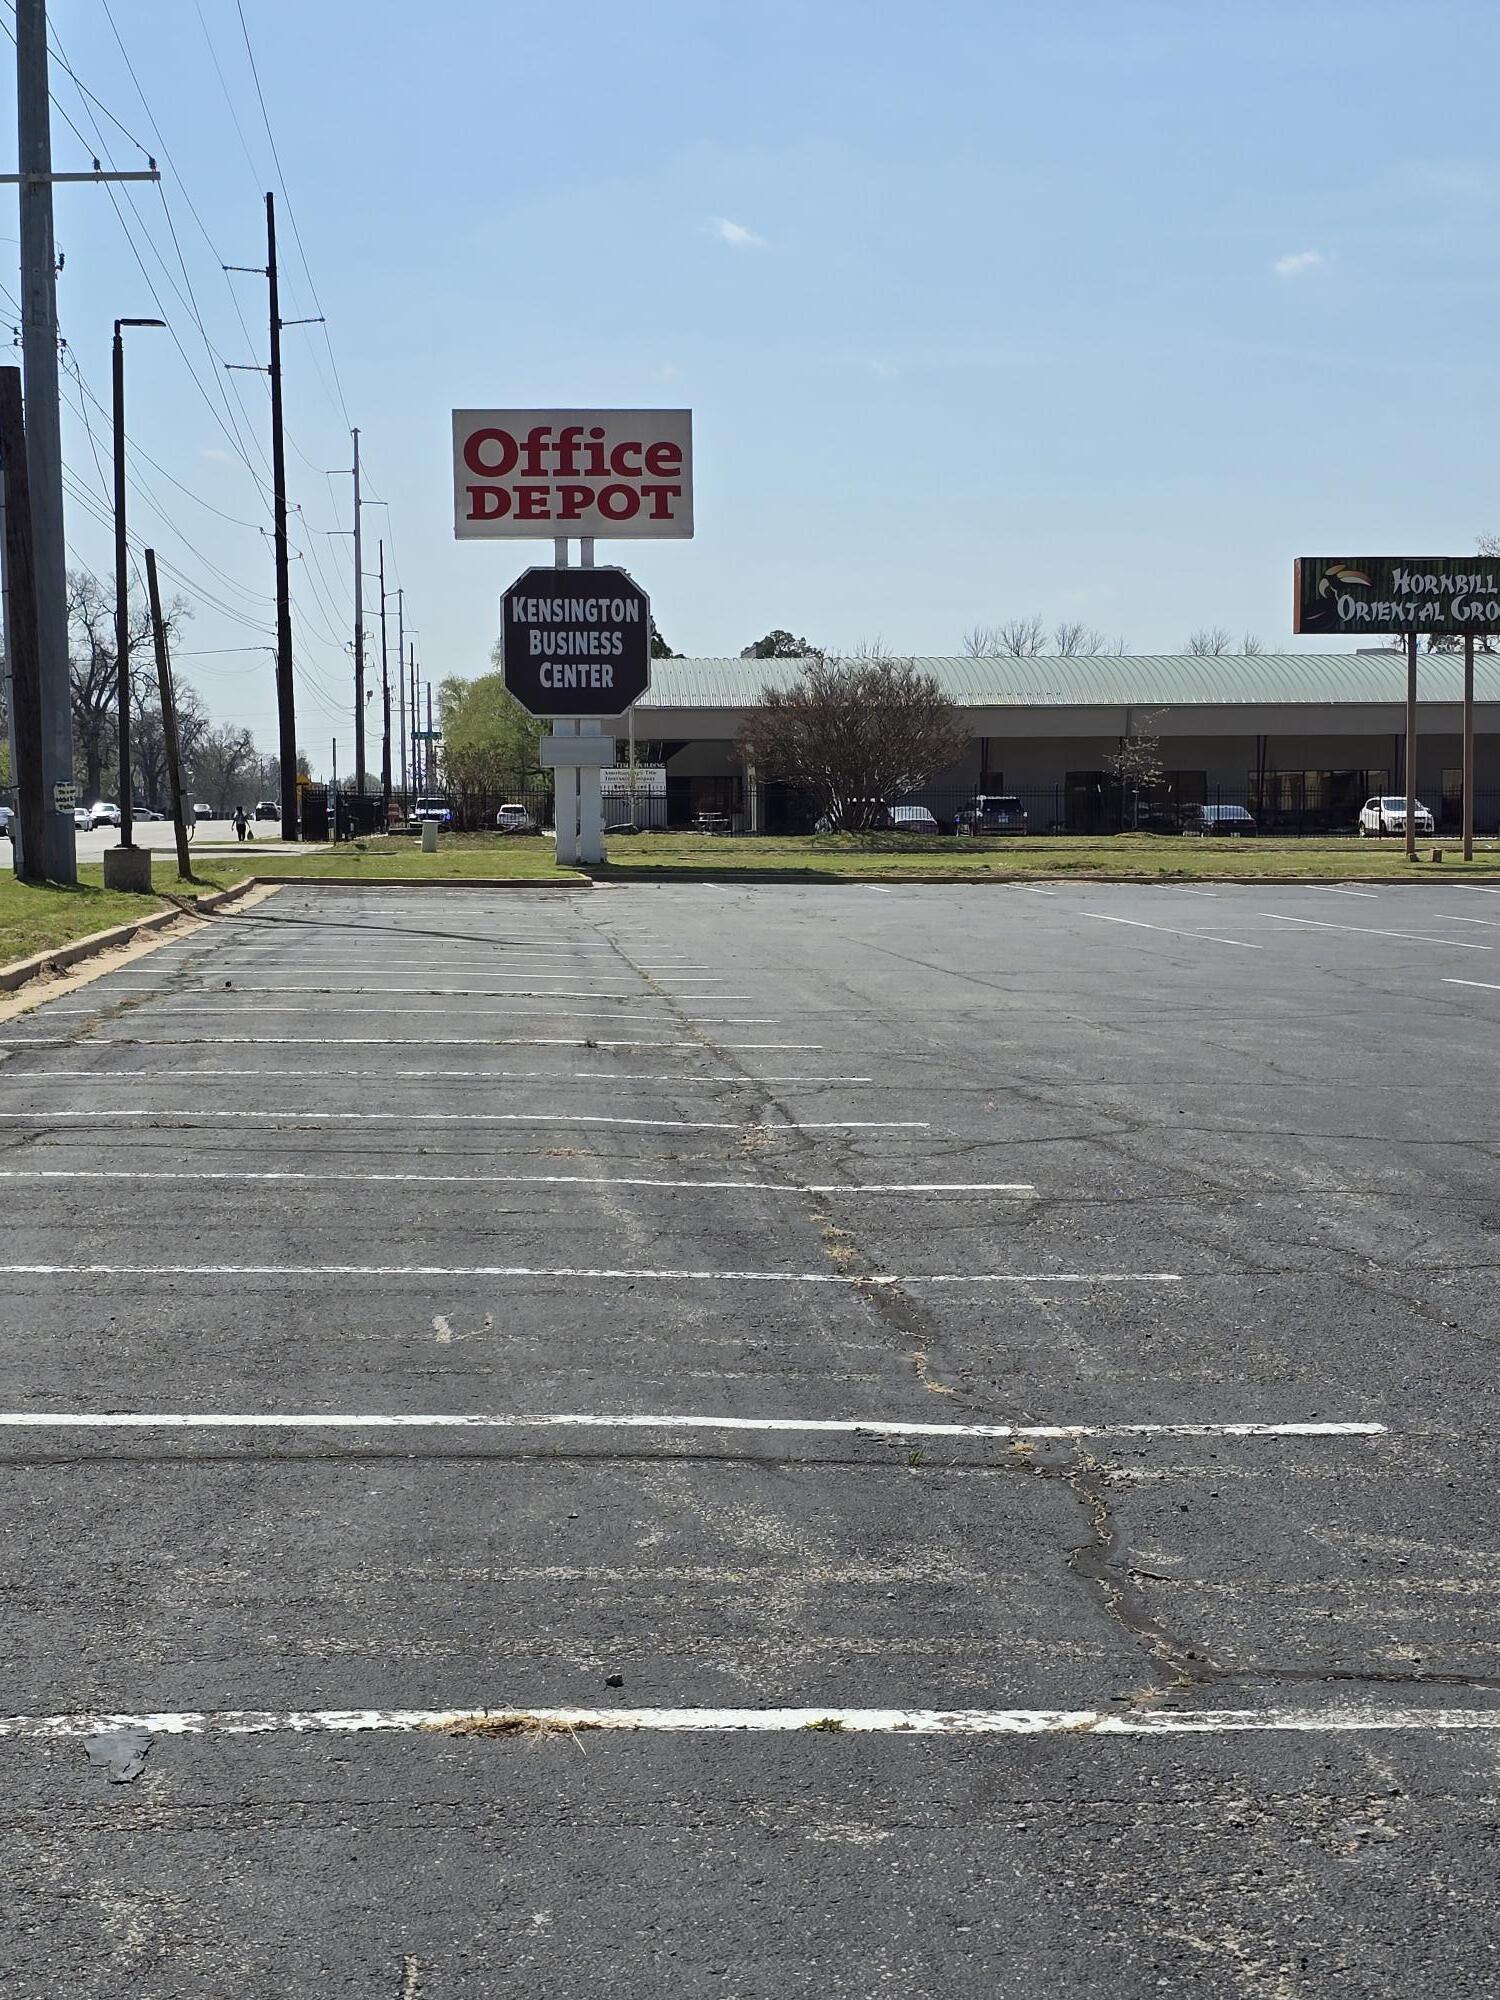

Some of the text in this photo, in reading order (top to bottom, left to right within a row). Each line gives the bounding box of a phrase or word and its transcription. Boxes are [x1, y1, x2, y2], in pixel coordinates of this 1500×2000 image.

[463, 426, 683, 478] Office
[466, 484, 682, 521] DEPOT
[1391, 567, 1499, 595] HORNBILL
[512, 596, 640, 624] KENSINGTON
[1337, 594, 1500, 622] ORIENTAL GRO
[529, 629, 624, 656] BUSINESS
[539, 662, 614, 688] CENTER
